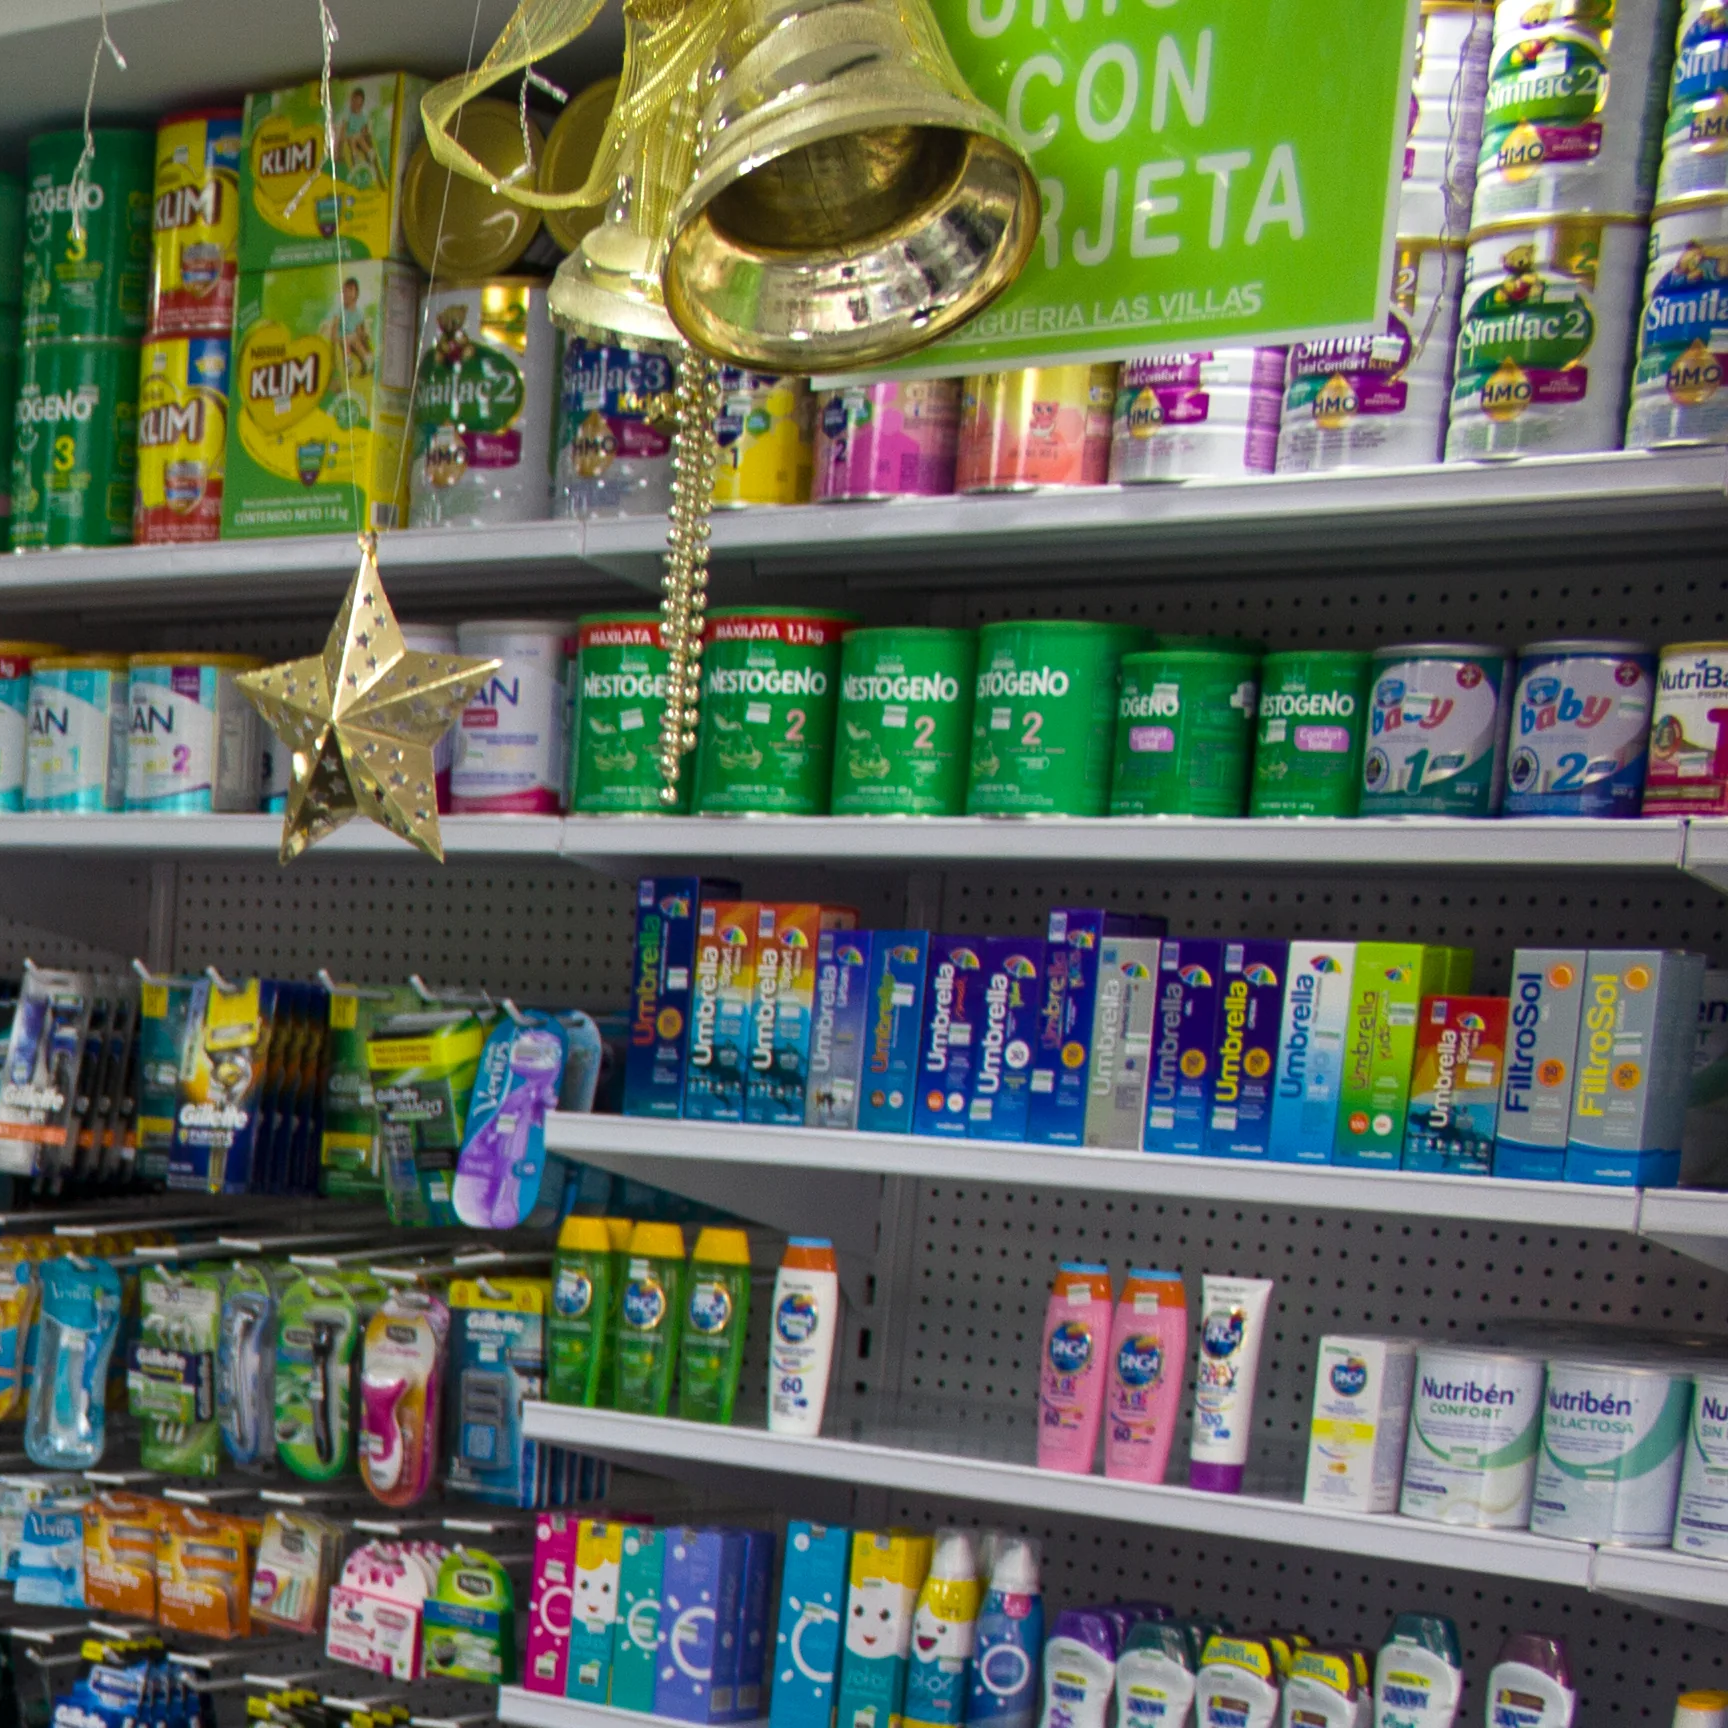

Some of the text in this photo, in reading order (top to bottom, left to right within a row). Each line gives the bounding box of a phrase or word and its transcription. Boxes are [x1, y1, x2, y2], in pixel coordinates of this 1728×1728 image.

[1007, 28, 1213, 152] CON
[259, 139, 314, 177] KLIM
[1495, 144, 1545, 169] HMO
[1041, 143, 1304, 270] RJETA
[954, 282, 1263, 341] OGUERIA LAS VILLAS
[1462, 310, 1588, 349] Similac 2
[1646, 294, 1728, 332] Simila
[250, 355, 321, 399] KLIM
[1480, 381, 1534, 404] HMO
[1665, 365, 1724, 388] HMO
[583, 670, 666, 698] NESTOGE
[709, 666, 828, 697] NESTOGENO
[845, 670, 959, 702] NESTOGENO
[1260, 685, 1355, 718] ESTOGENO
[1520, 690, 1613, 736] baby
[785, 708, 806, 741] 2
[914, 716, 936, 749] 2
[1022, 710, 1044, 745] 2
[1404, 747, 1430, 794] 1
[692, 946, 720, 1066] Umbrella
[752, 948, 779, 1071] Umbrella
[927, 963, 955, 1073] Umbrella
[979, 972, 1010, 1095] Umbrella
[1216, 979, 1248, 1102] Umbrella
[1279, 972, 1316, 1100] Umbrella
[1505, 971, 1544, 1115] FiltroSol
[1578, 972, 1620, 1118] FiltroSol
[1429, 1028, 1458, 1129] Umbrella
[178, 1102, 249, 1131] Gillette
[781, 1376, 803, 1395] 60
[1421, 1375, 1515, 1406] Nutribén
[1429, 1402, 1504, 1421] CONFORT
[1558, 1414, 1635, 1435] LACTOSA
